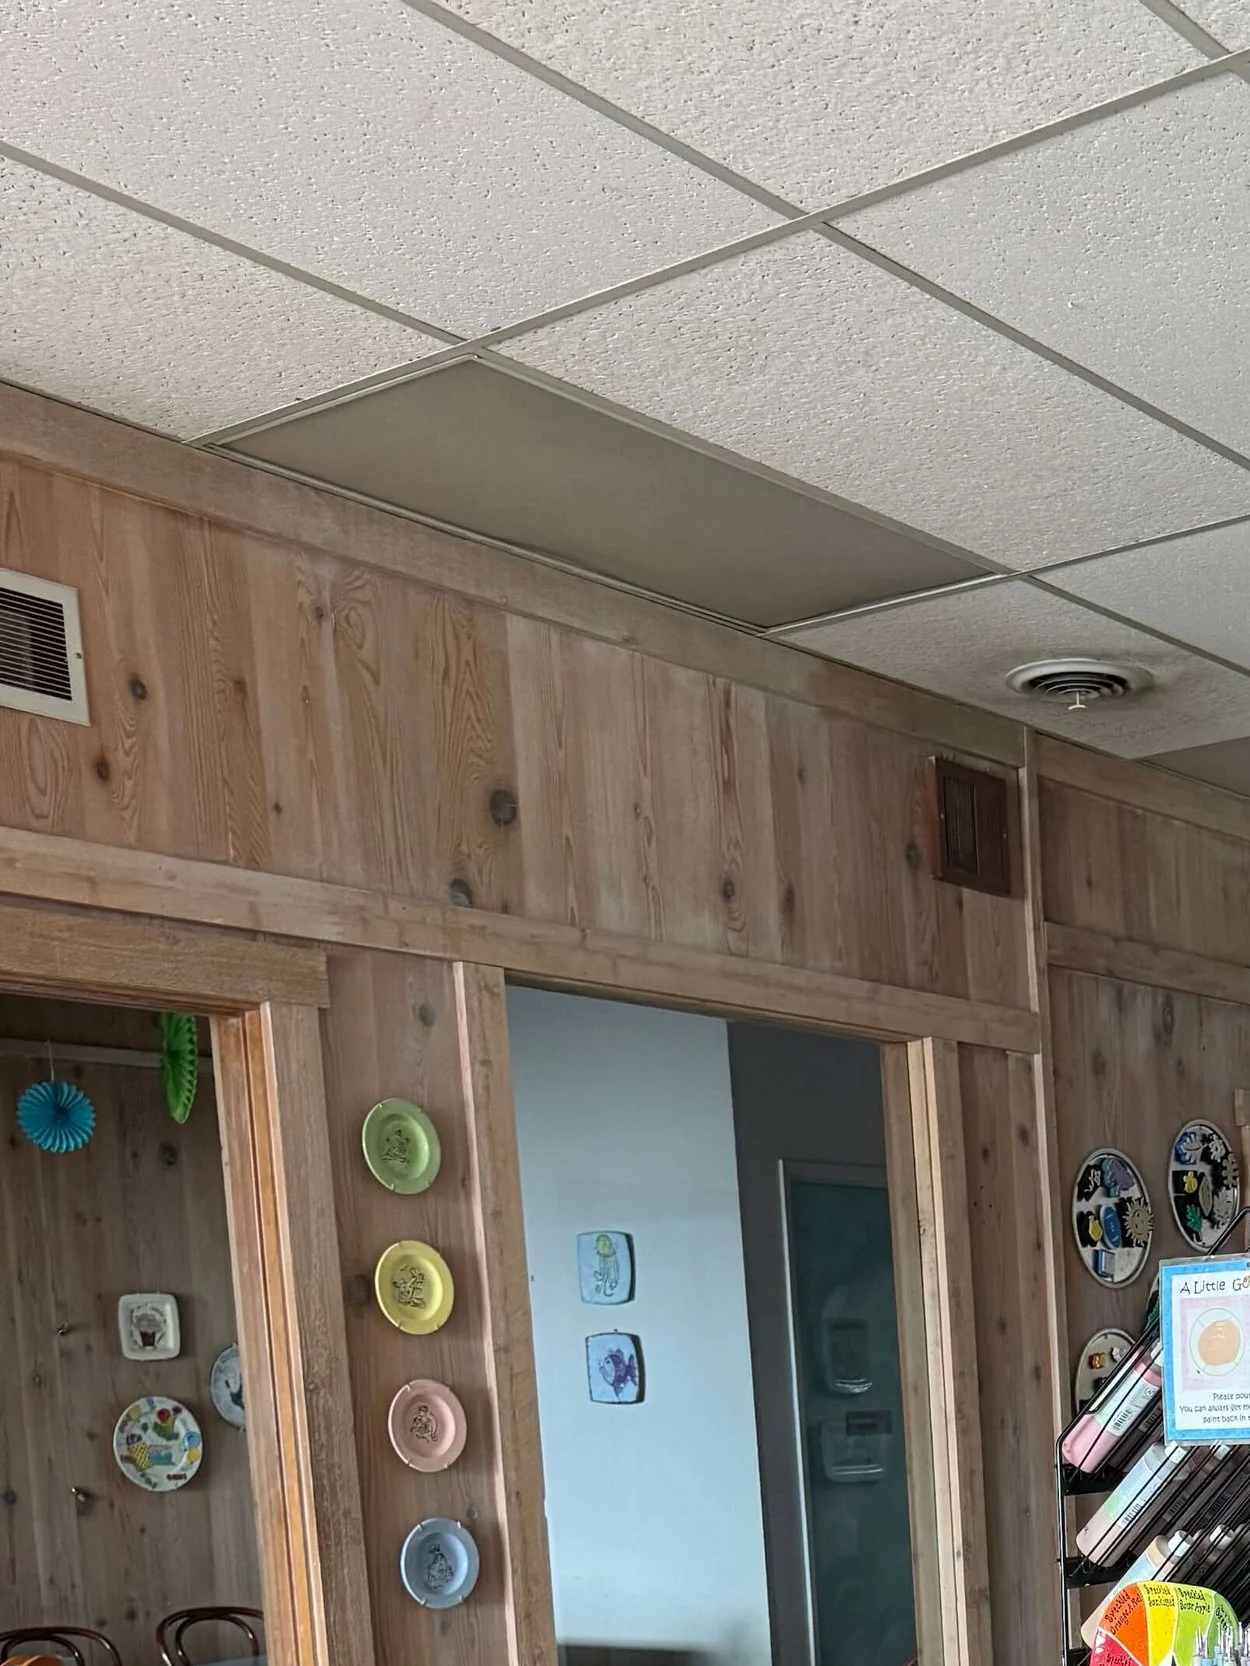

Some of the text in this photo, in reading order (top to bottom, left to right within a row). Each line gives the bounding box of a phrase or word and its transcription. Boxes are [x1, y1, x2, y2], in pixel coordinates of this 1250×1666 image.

[1180, 1281, 1191, 1295] A
[1194, 1279, 1226, 1295] Little
[1213, 1392, 1234, 1401] Please
[1179, 1405, 1193, 1414] You
[1194, 1405, 1207, 1413] can
[1207, 1404, 1229, 1412] always
[1231, 1404, 1242, 1413] get
[1202, 1415, 1220, 1424] paint
[1221, 1413, 1238, 1423] back
[1239, 1413, 1246, 1422] in
